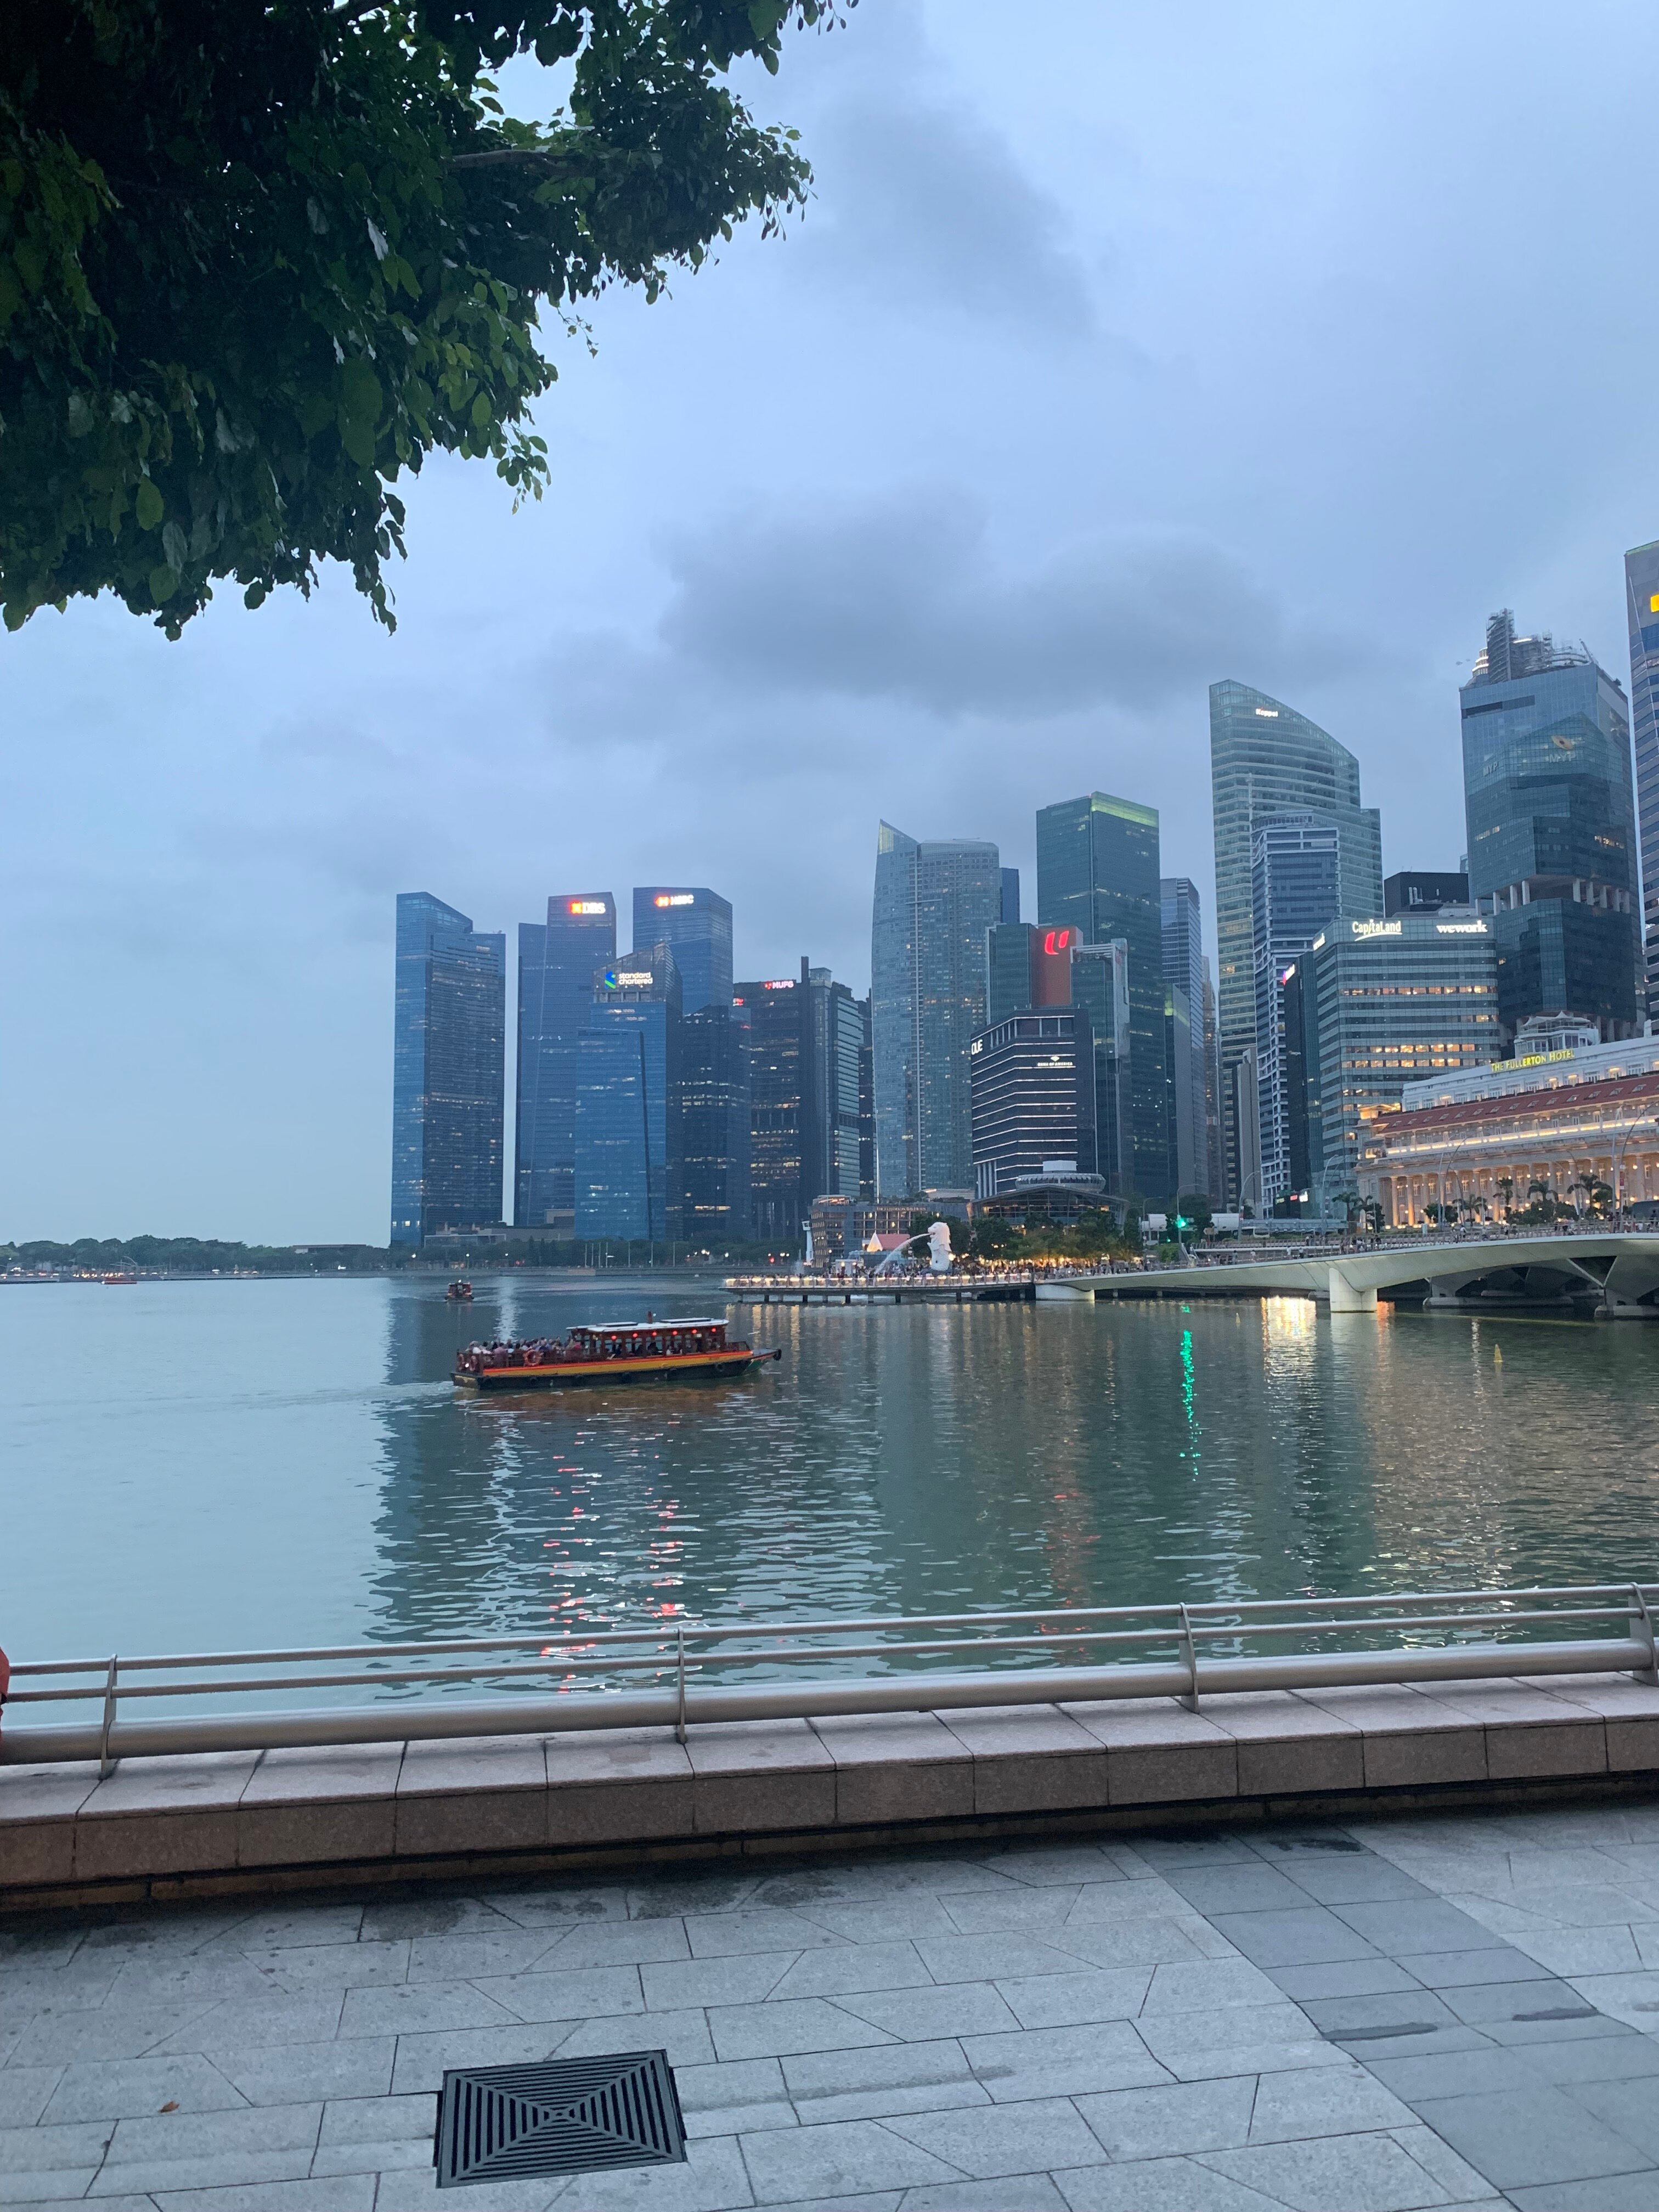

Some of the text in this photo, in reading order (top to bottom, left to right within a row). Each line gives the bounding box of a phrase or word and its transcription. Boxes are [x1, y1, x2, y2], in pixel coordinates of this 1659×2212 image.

[1549, 752, 1577, 763] MYP
[1483, 761, 1499, 777] MYP
[582, 902, 606, 914] DBS
[1352, 919, 1402, 935] CapitaLand
[1436, 920, 1488, 933] wework
[772, 980, 794, 989] MUFG
[971, 1039, 983, 1055] OUE
[1491, 1049, 1575, 1071] THE FULLERTON HOTEL
